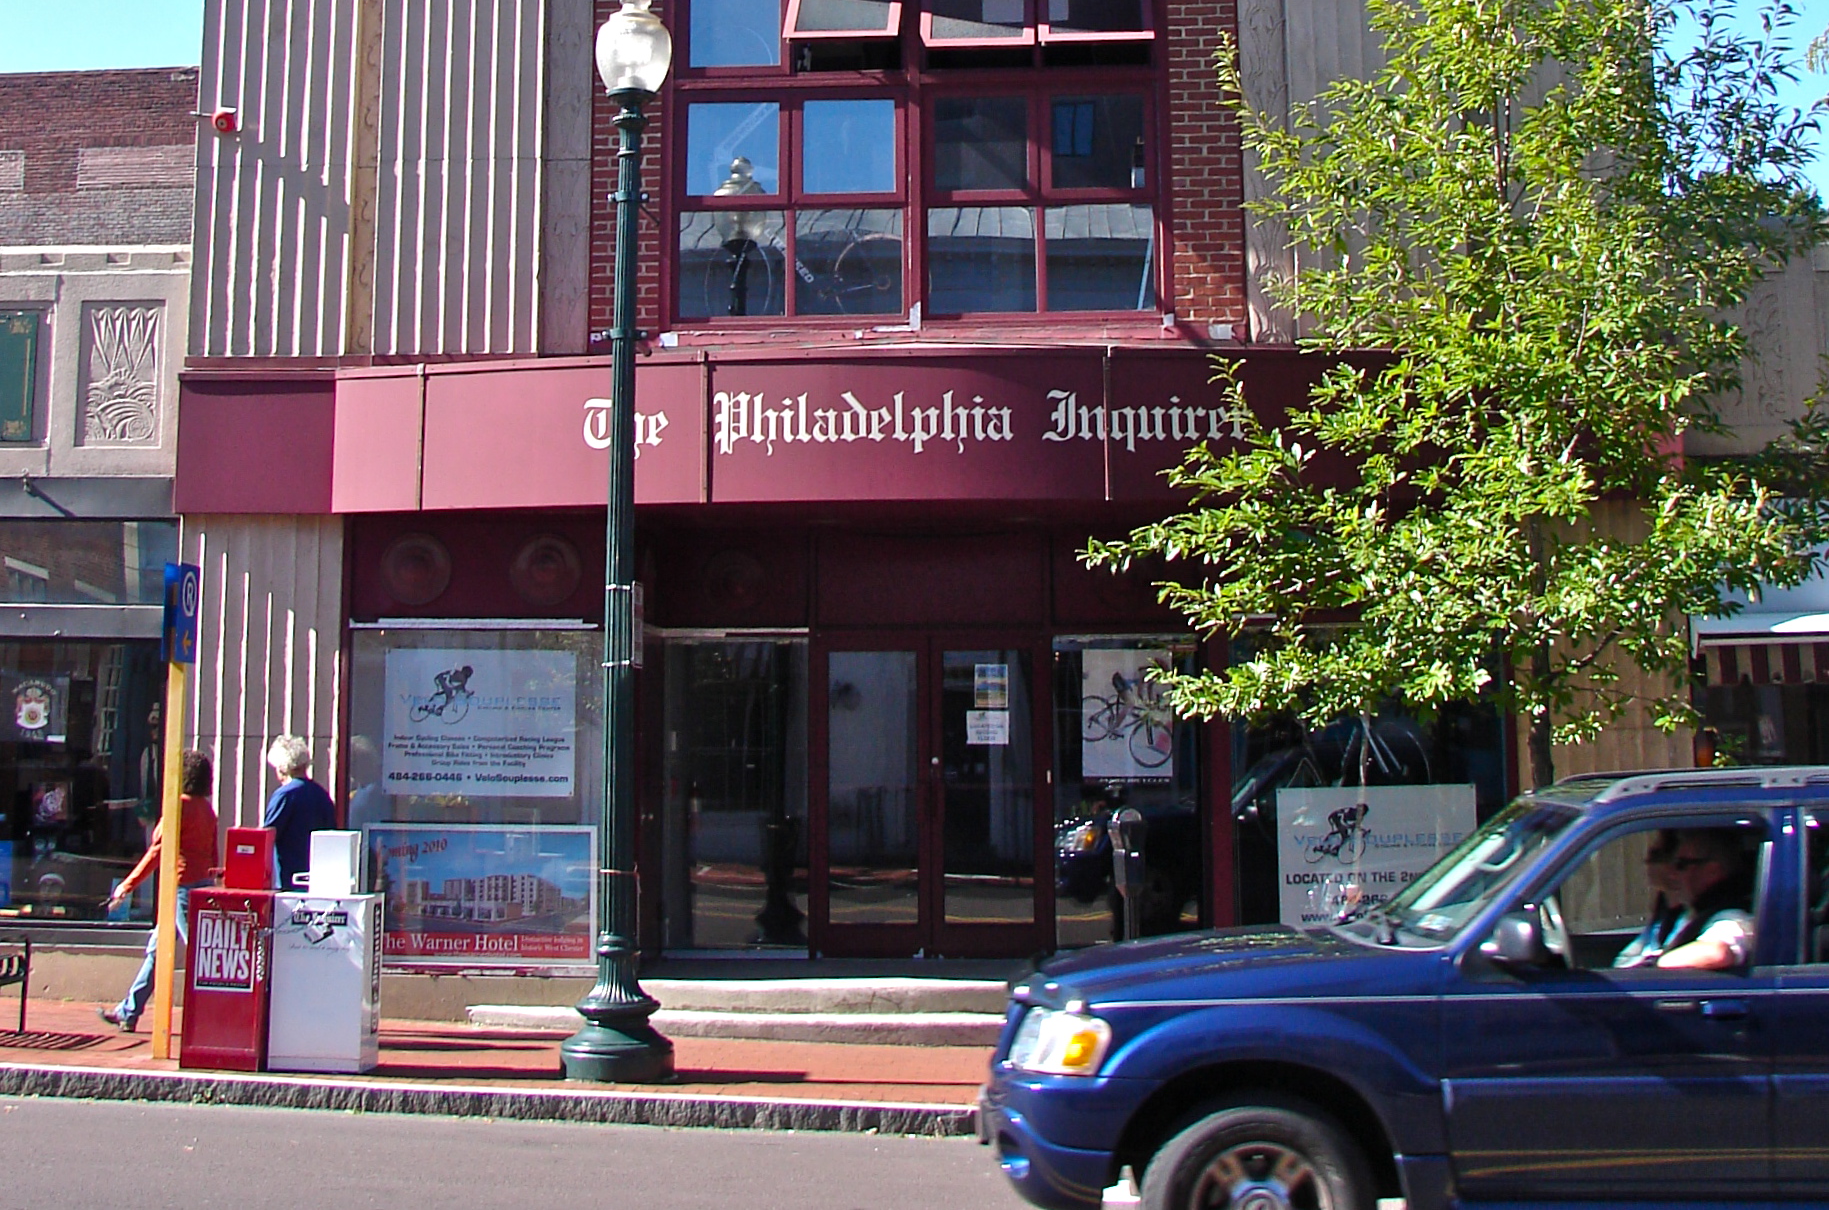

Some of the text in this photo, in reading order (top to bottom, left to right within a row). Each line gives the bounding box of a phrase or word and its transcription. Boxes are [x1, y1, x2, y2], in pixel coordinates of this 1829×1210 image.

[713, 390, 1014, 456] Philadelphia
[1042, 389, 1247, 452] Inquirer
[475, 773, 569, 784] VeloSouplesse.com
[421, 837, 448, 854] 2010
[1347, 872, 1367, 884] ON
[1370, 871, 1396, 883] THE
[200, 917, 250, 950] DAILY
[410, 934, 471, 952] Warner
[474, 934, 519, 952] Hotel
[198, 947, 251, 980] NEWS
